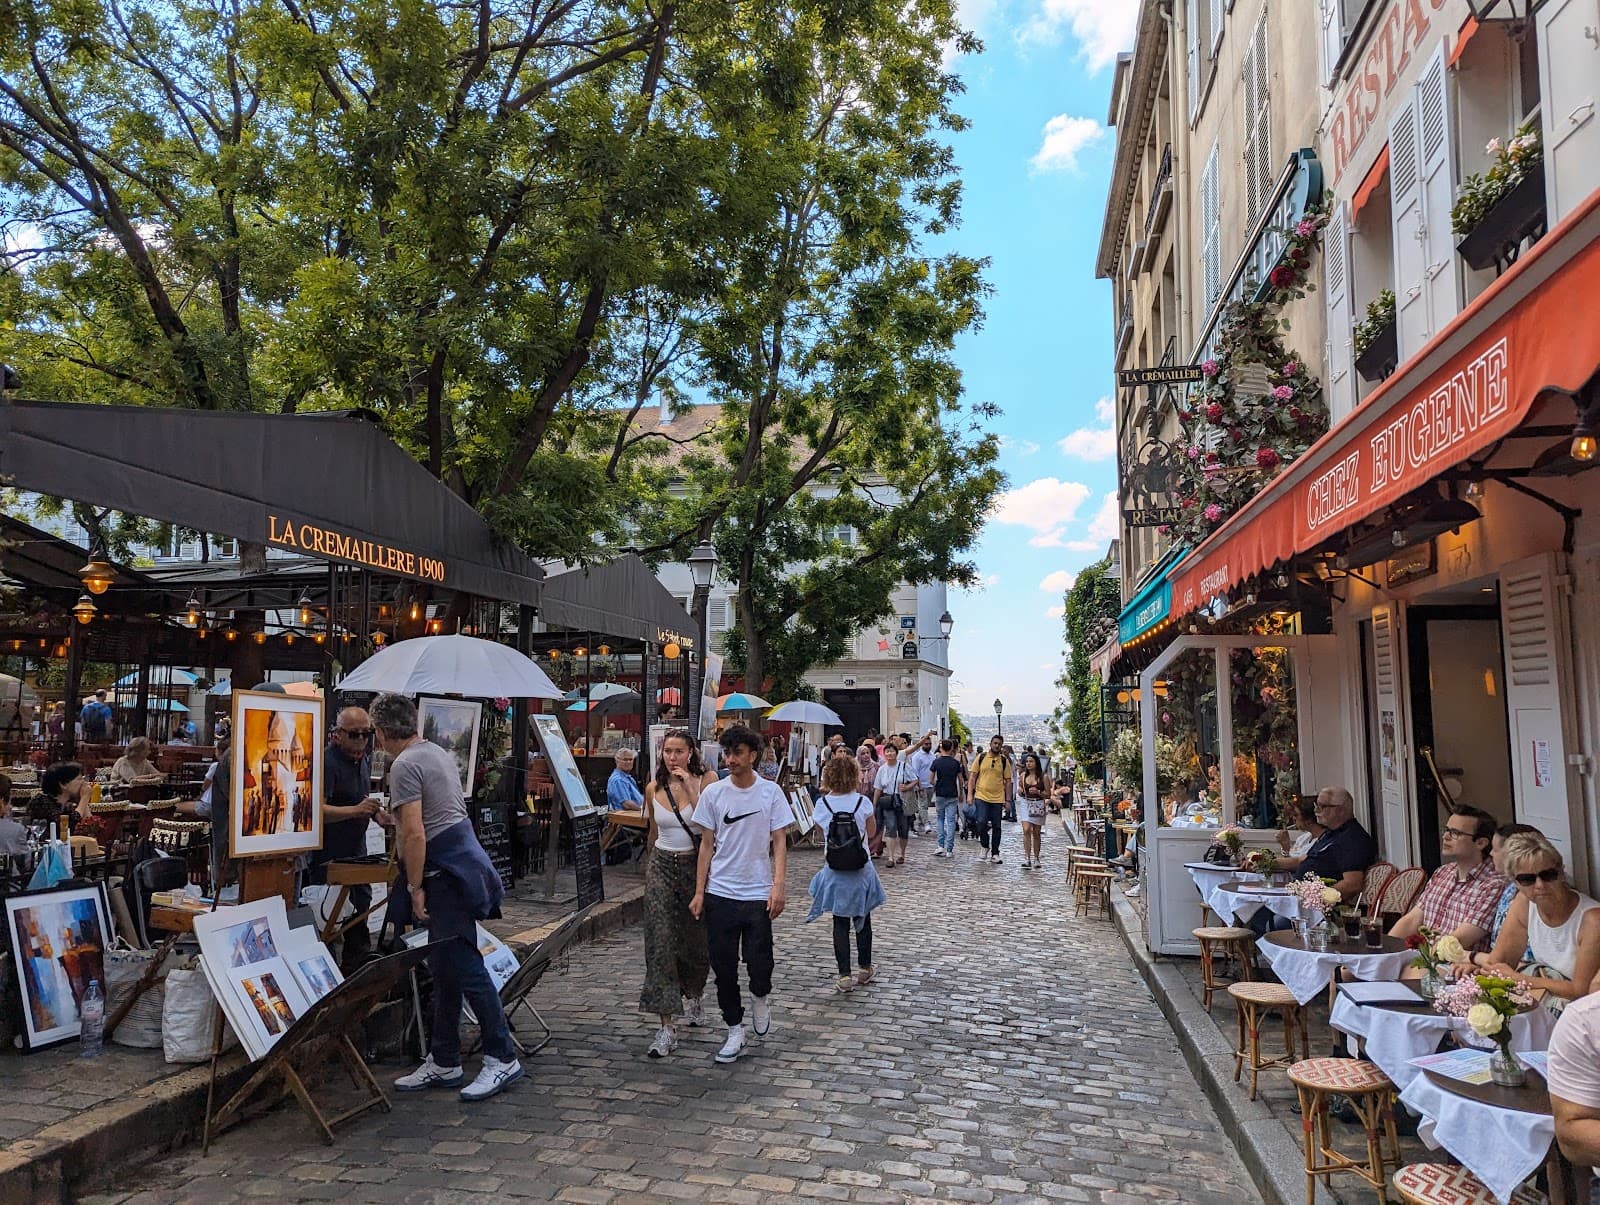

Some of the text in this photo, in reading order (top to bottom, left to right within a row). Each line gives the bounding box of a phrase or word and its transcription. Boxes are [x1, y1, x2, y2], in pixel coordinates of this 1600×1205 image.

[1330, 0, 1447, 188] RESTA
[1126, 373, 1138, 382] LA
[1306, 336, 1508, 530] CHEZ EUGENE
[268, 515, 445, 582] LA CREMAILLERE 1900
